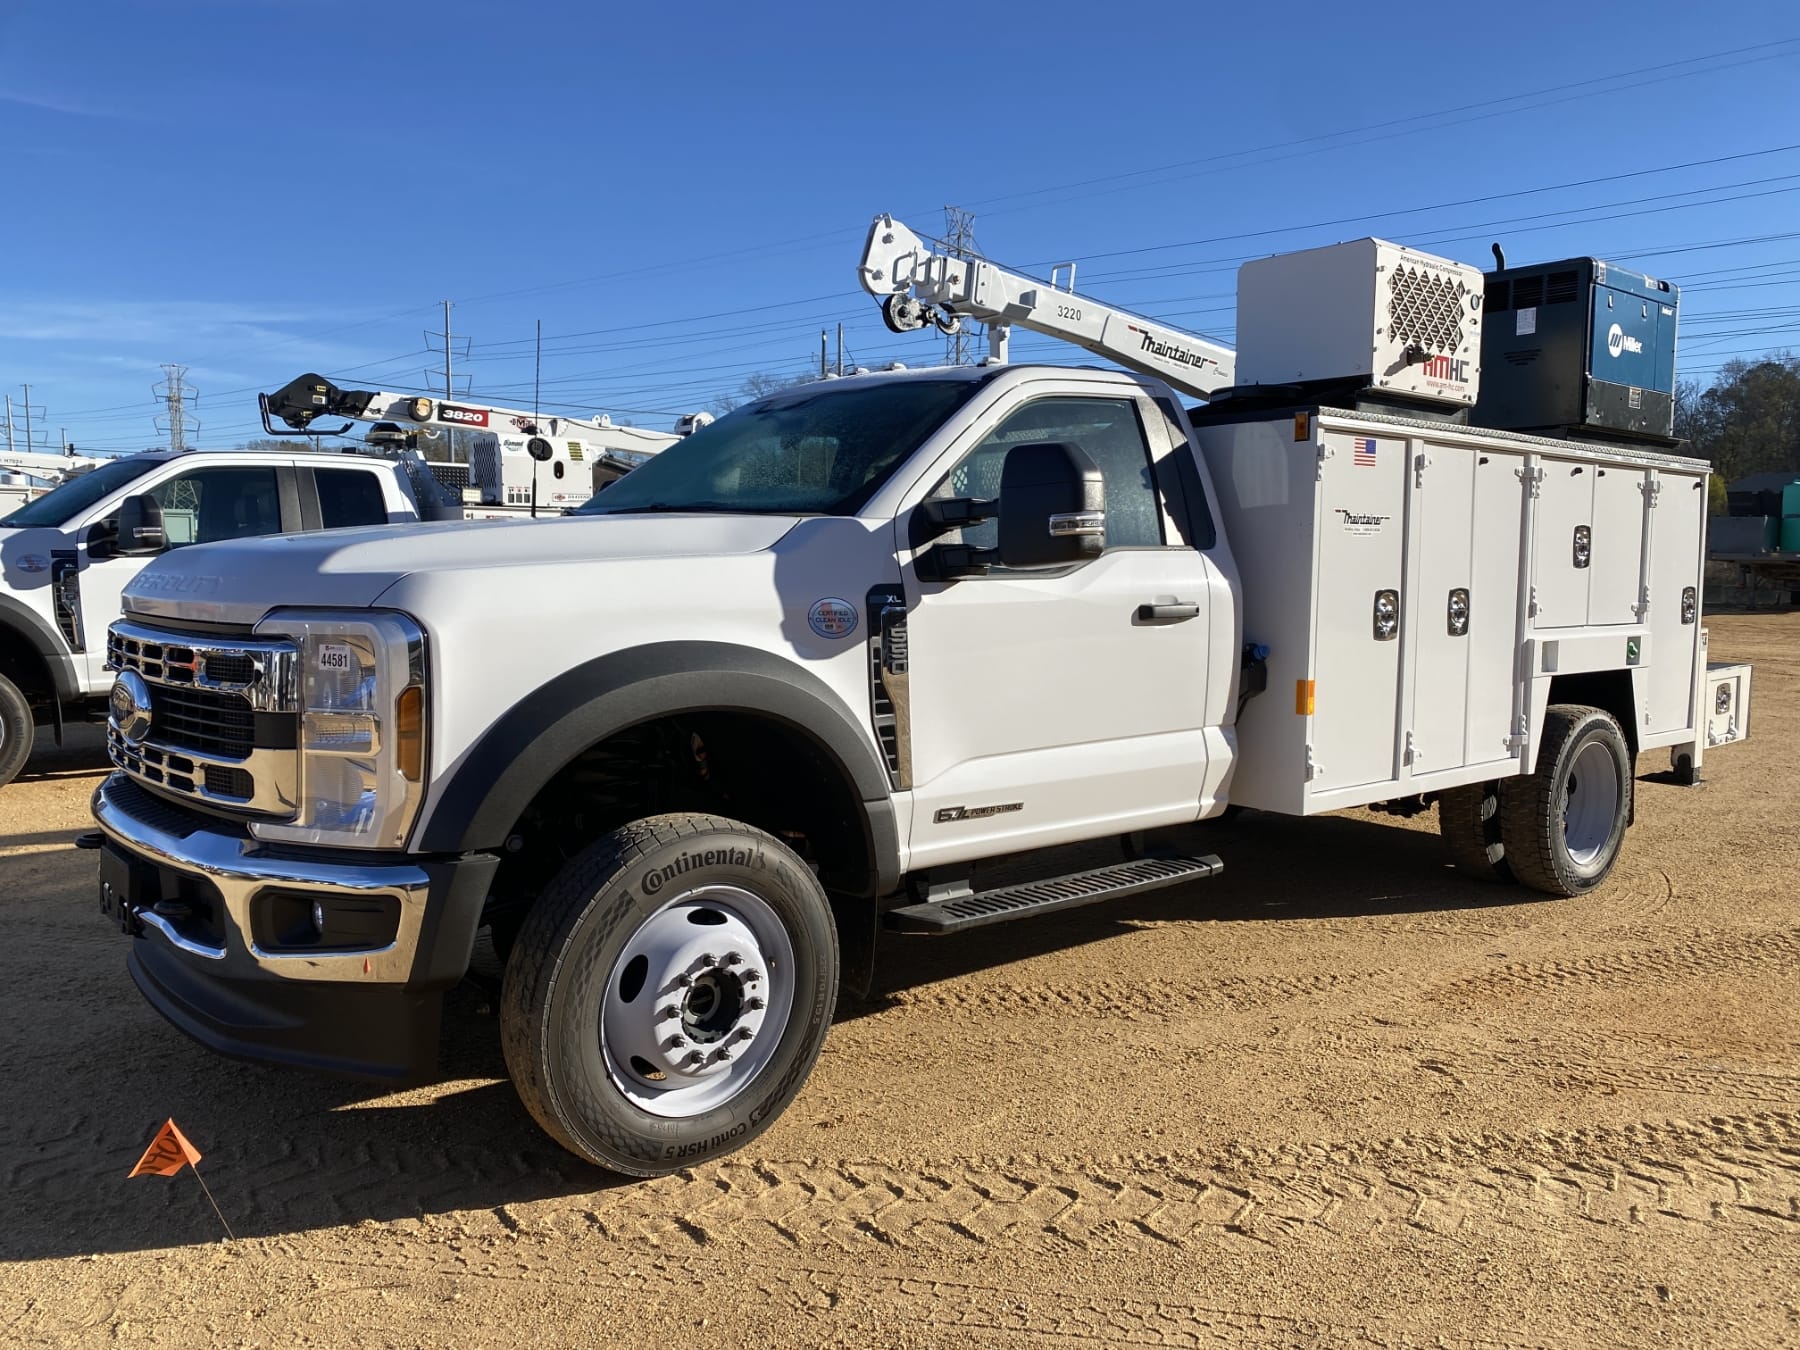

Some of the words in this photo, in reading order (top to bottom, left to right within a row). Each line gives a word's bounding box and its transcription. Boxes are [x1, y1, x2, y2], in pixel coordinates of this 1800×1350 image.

[1057, 305, 1082, 321] 3220
[1138, 328, 1209, 369] Maintainer
[1622, 335, 1642, 354] Miller
[442, 409, 484, 423] 3820
[887, 595, 902, 603] XL
[321, 653, 348, 667] 44581
[971, 806, 995, 816] POWER
[996, 802, 1024, 813] STROKE
[641, 846, 754, 896] Continental
[711, 1122, 747, 1149] Conti
[664, 1147, 675, 1159] 5
[677, 1142, 708, 1158] HSR
